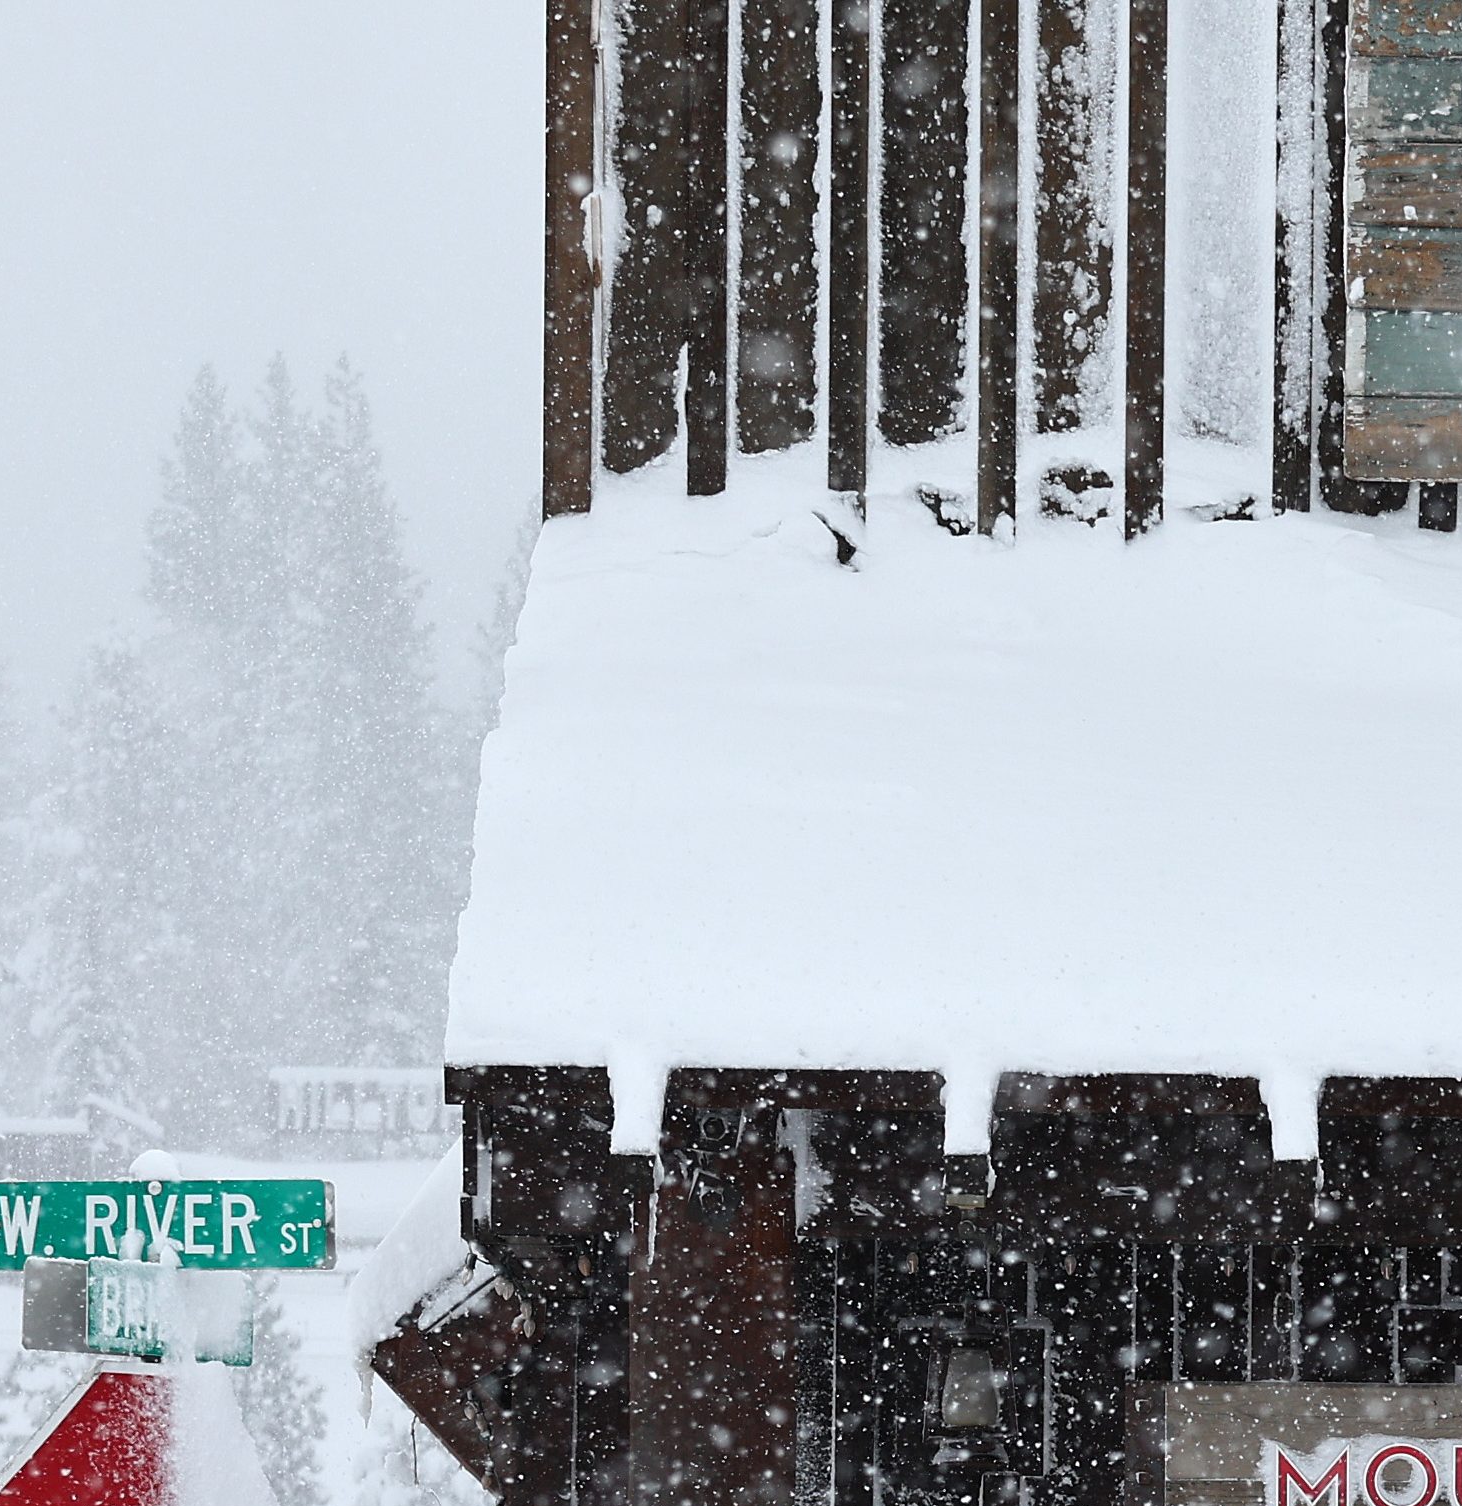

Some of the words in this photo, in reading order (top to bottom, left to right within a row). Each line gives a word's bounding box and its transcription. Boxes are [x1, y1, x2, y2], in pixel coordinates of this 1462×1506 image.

[279, 1082, 450, 1131] HILLTO
[85, 1193, 258, 1257] RIVER
[279, 1222, 317, 1255] ST
